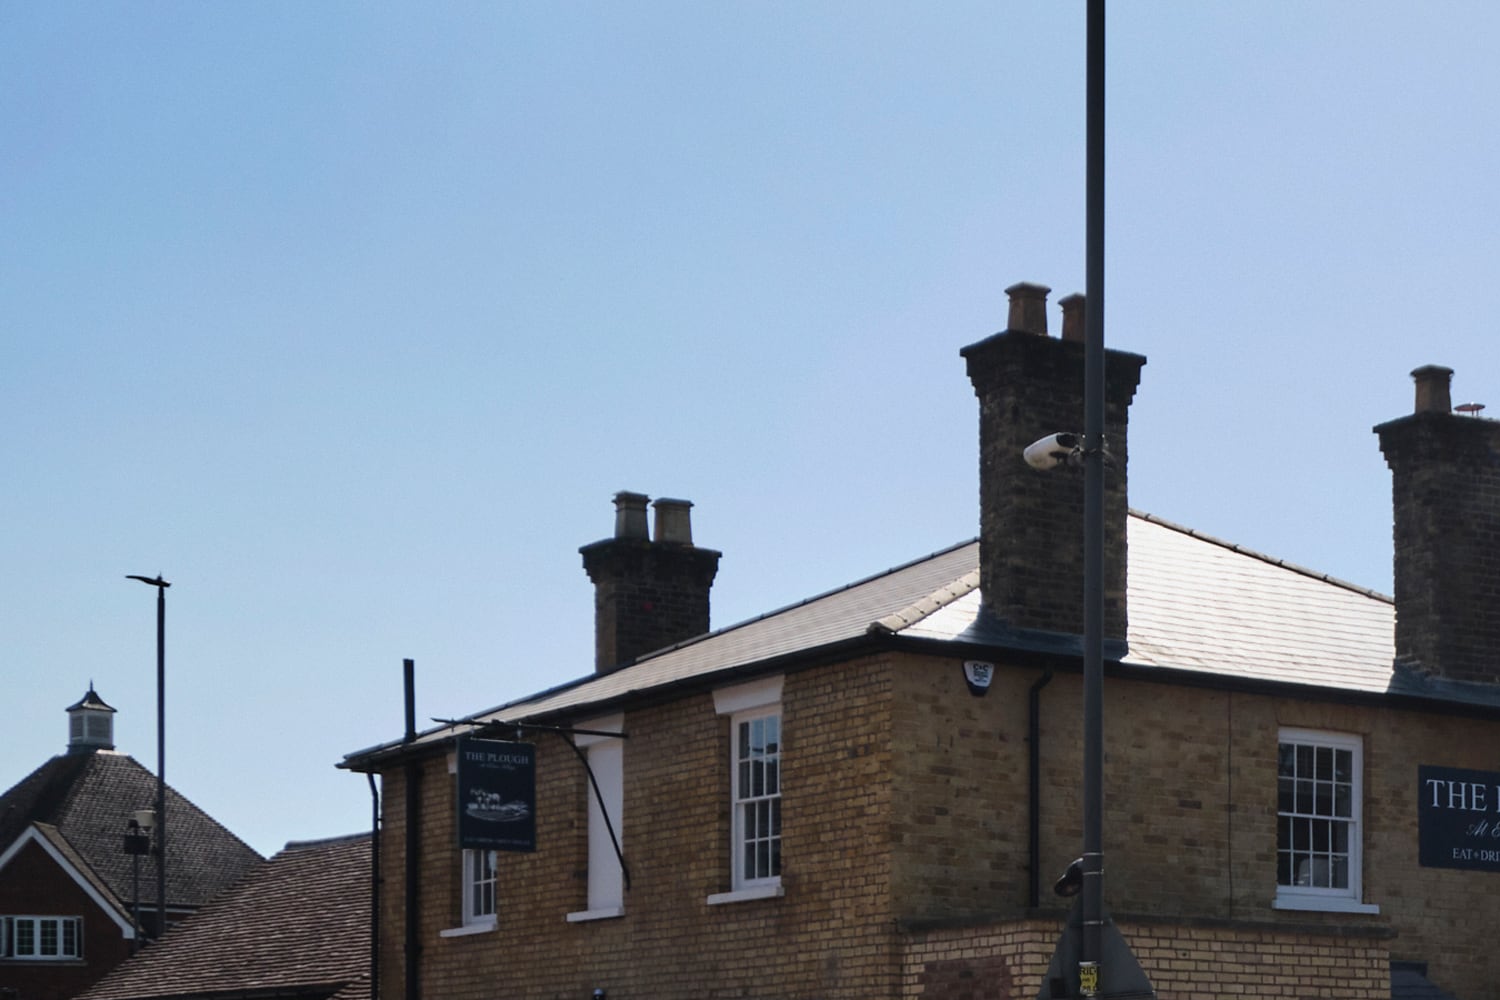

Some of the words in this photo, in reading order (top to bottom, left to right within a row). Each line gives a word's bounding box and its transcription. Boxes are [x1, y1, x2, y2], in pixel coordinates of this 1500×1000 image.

[465, 751, 485, 761] THE
[487, 753, 529, 765] PLOUGH
[1425, 779, 1488, 812] THE
[1465, 820, 1489, 838] At
[1452, 847, 1473, 860] EAT
